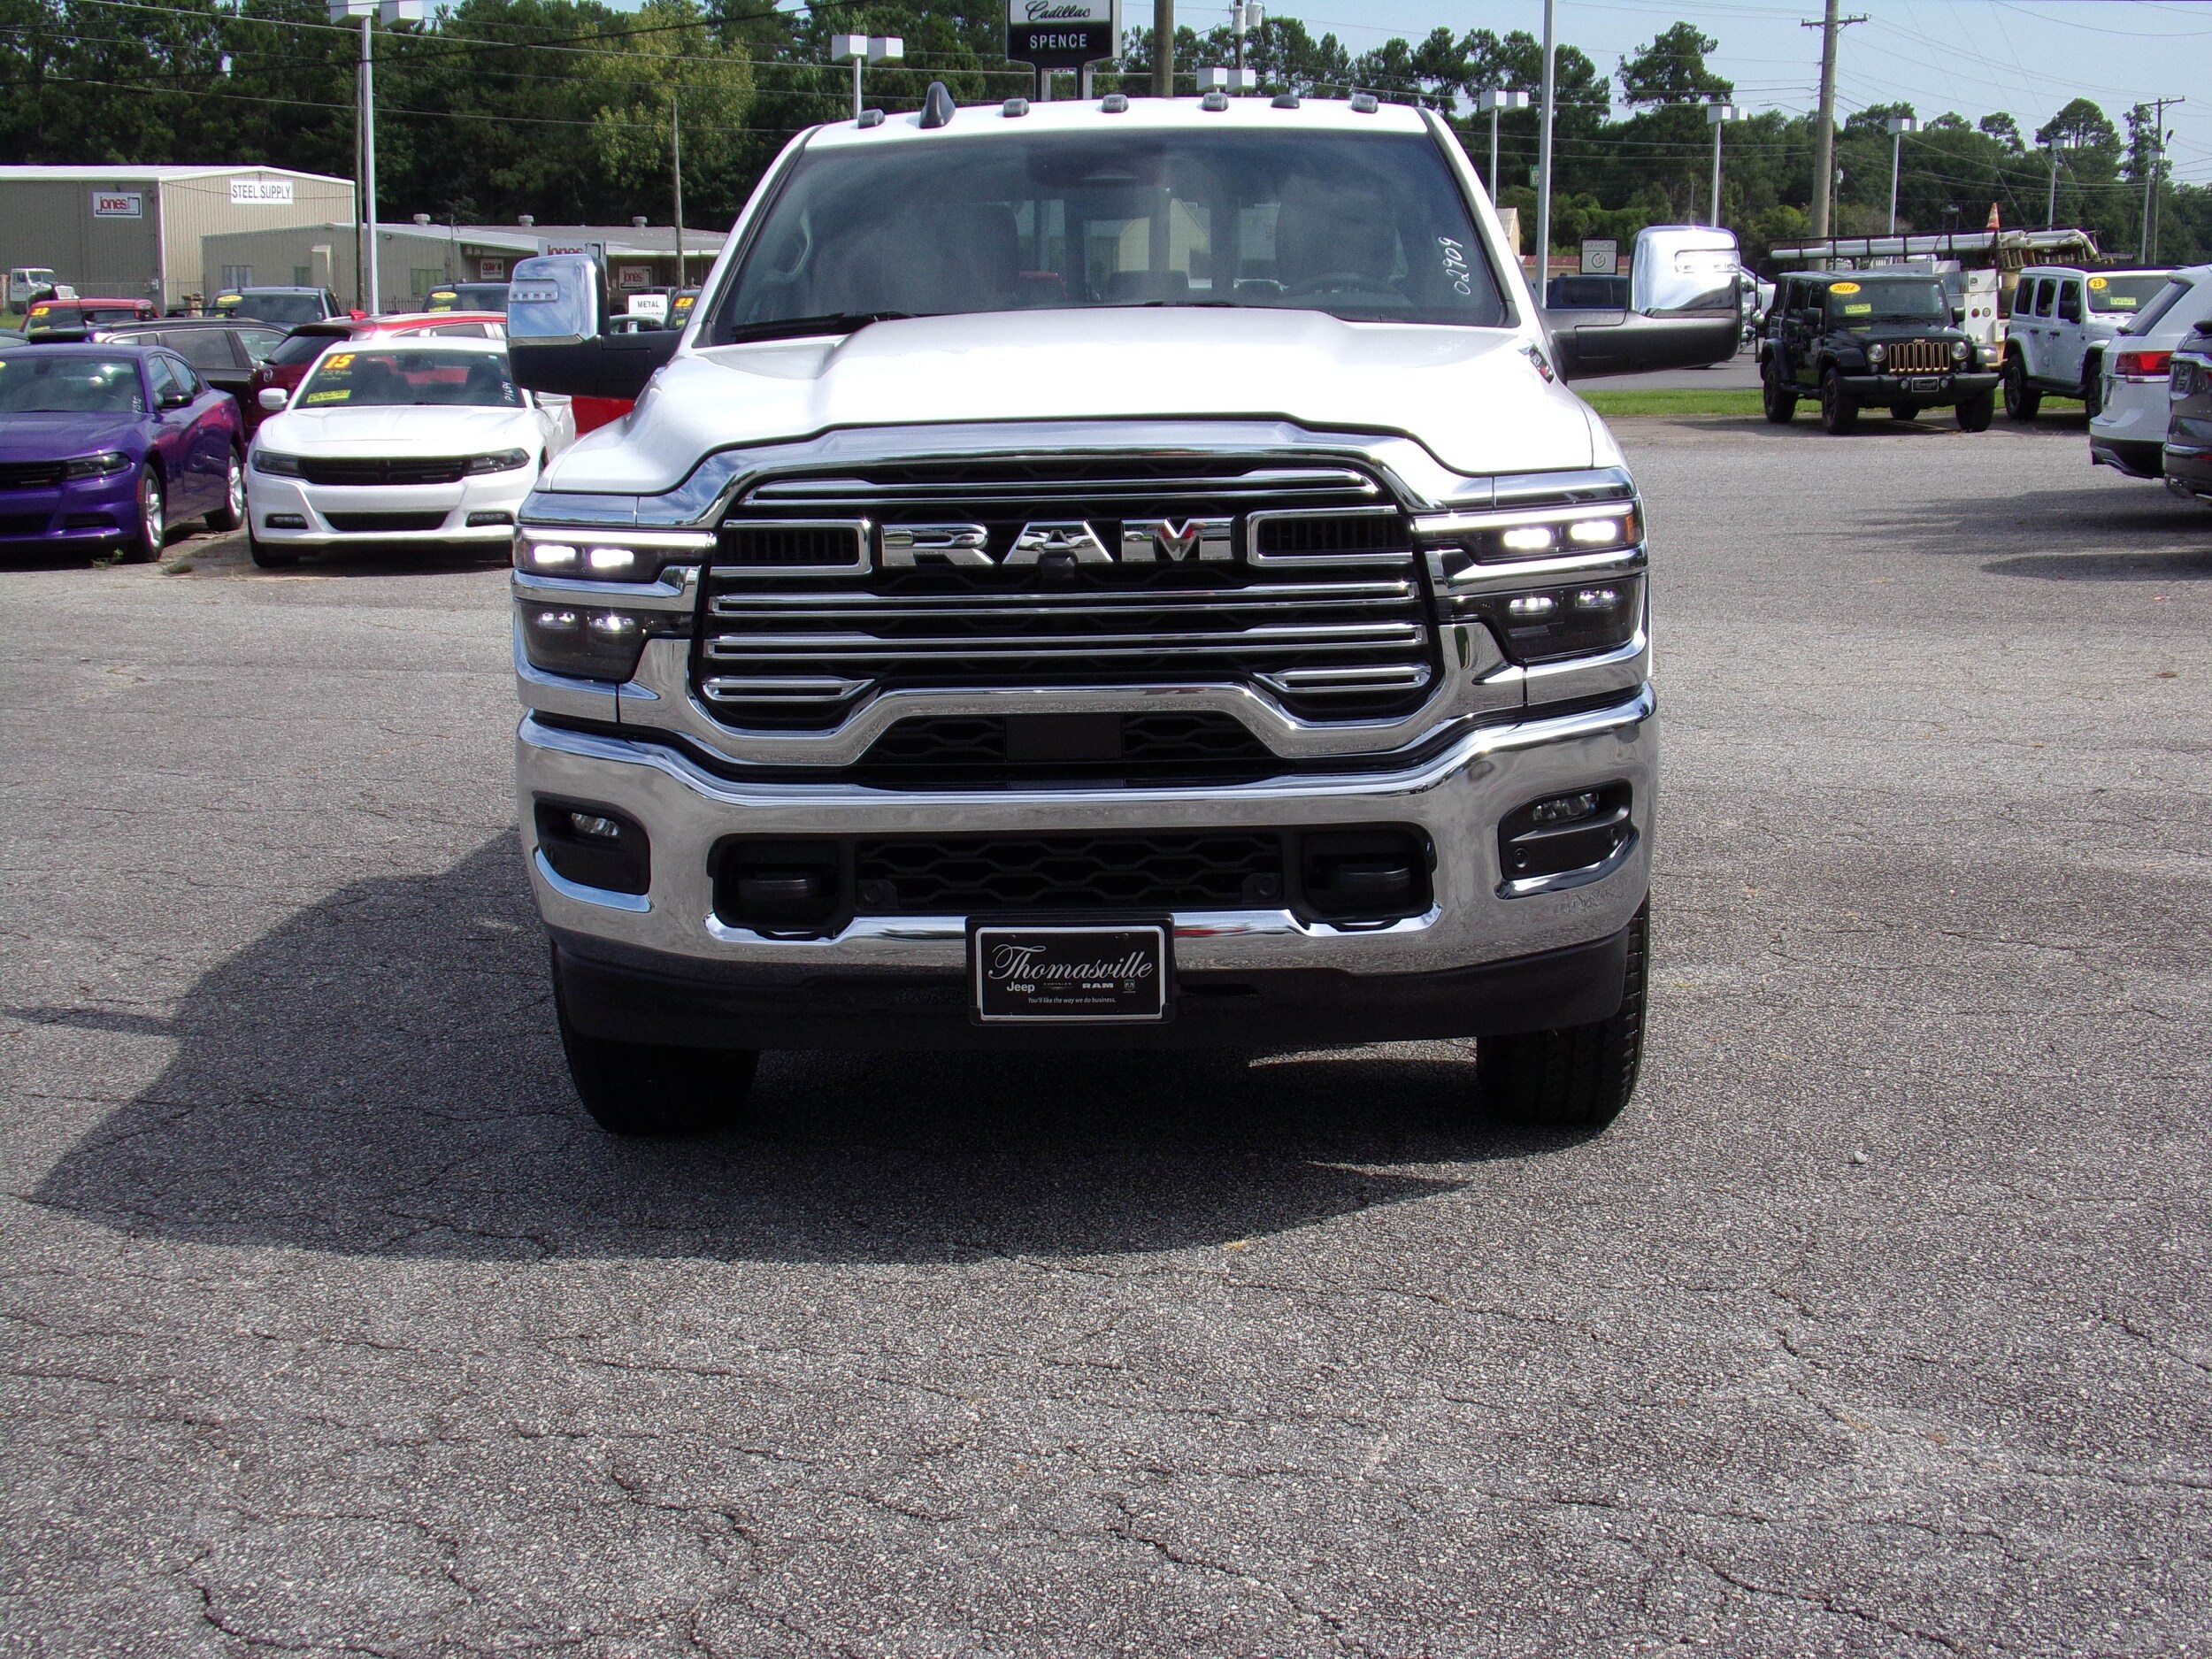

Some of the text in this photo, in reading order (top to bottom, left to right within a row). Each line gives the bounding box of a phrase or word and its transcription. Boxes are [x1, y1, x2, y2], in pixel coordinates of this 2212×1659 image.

[1025, 1, 1091, 21] Cadillac
[1029, 34, 1087, 49] SPENCE
[232, 185, 291, 199] STEEL SUPPLY
[99, 196, 128, 211] jones
[1438, 236, 1471, 296] 02909
[675, 297, 693, 307] 23
[323, 354, 356, 369] 15
[881, 517, 1235, 566] RAM
[987, 944, 1153, 979] Thomasville
[1006, 981, 1035, 993] Jeep
